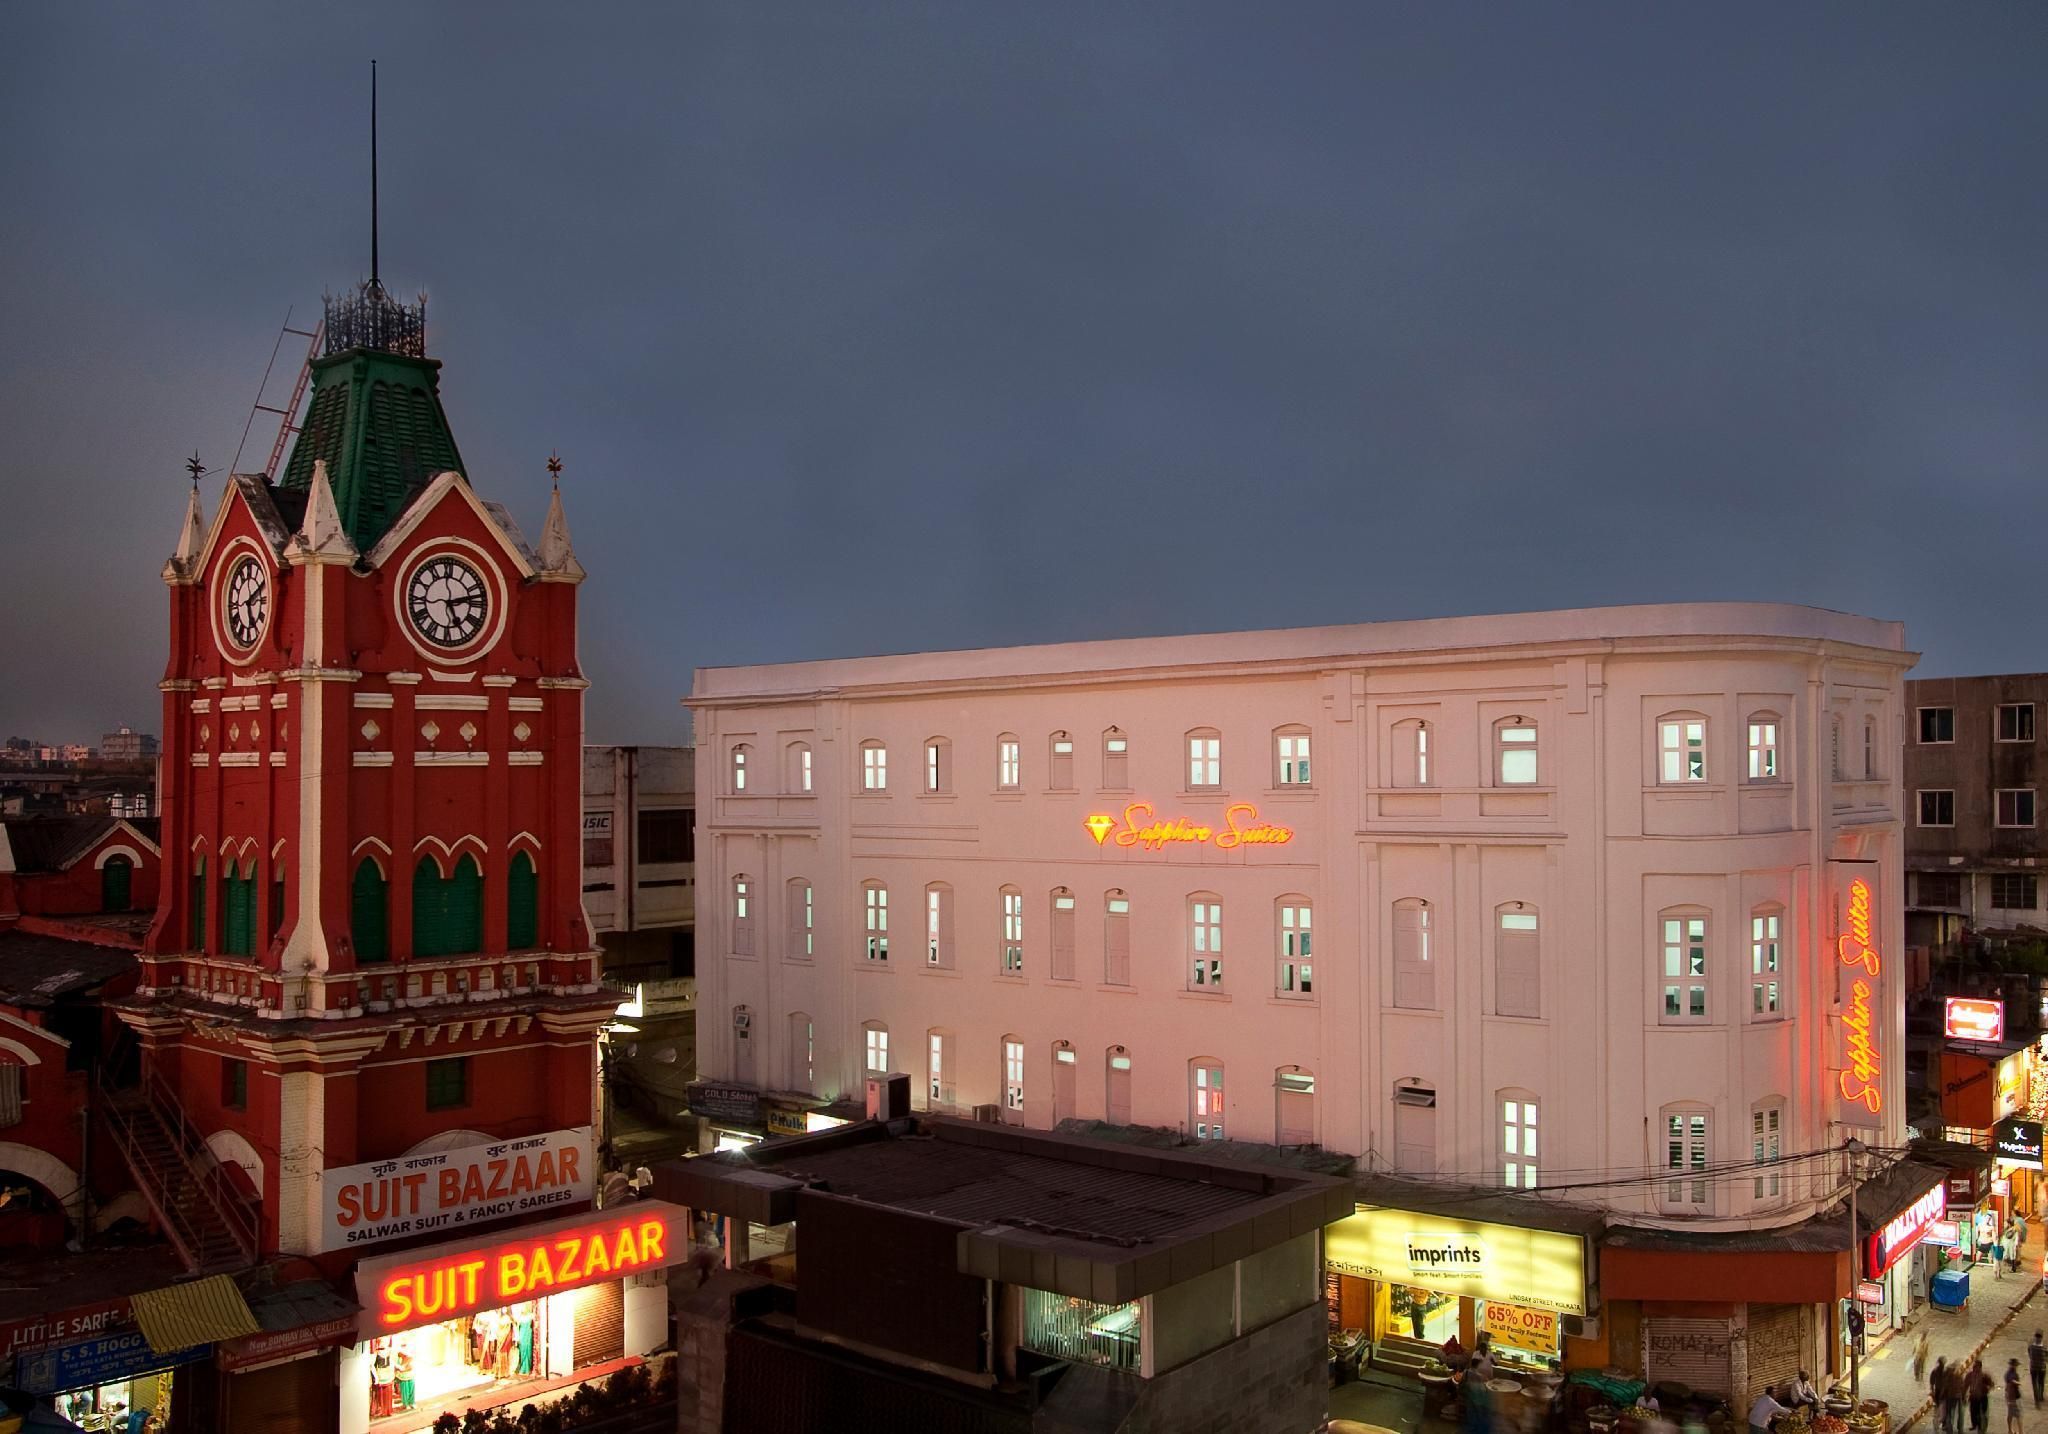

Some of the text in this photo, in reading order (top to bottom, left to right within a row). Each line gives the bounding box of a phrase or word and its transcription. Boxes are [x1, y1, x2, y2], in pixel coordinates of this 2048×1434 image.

[1115, 803, 1292, 850] Sapphire Suites
[1838, 878, 1881, 1113] Sapphire Suites
[336, 1146, 580, 1228] SUIT BAZAAR
[347, 1189, 572, 1242] SALWAR SUIT & FANCY SAREES
[1885, 1183, 1944, 1254] BOLLYWOOD
[1408, 1244, 1482, 1266] imprints
[383, 1221, 664, 1324] SUIT BAZAAR
[1509, 1294, 1531, 1302] LINDSAY
[1555, 1301, 1581, 1311] KOLKATA
[1487, 1306, 1552, 1330] 65% OFF
[13, 1320, 65, 1345] LITTLE
[97, 1334, 141, 1353] HOGG
[268, 1330, 299, 1346] BOMBAY
[1507, 1326, 1525, 1337] Family
[1526, 1329, 1551, 1340] Footwear
